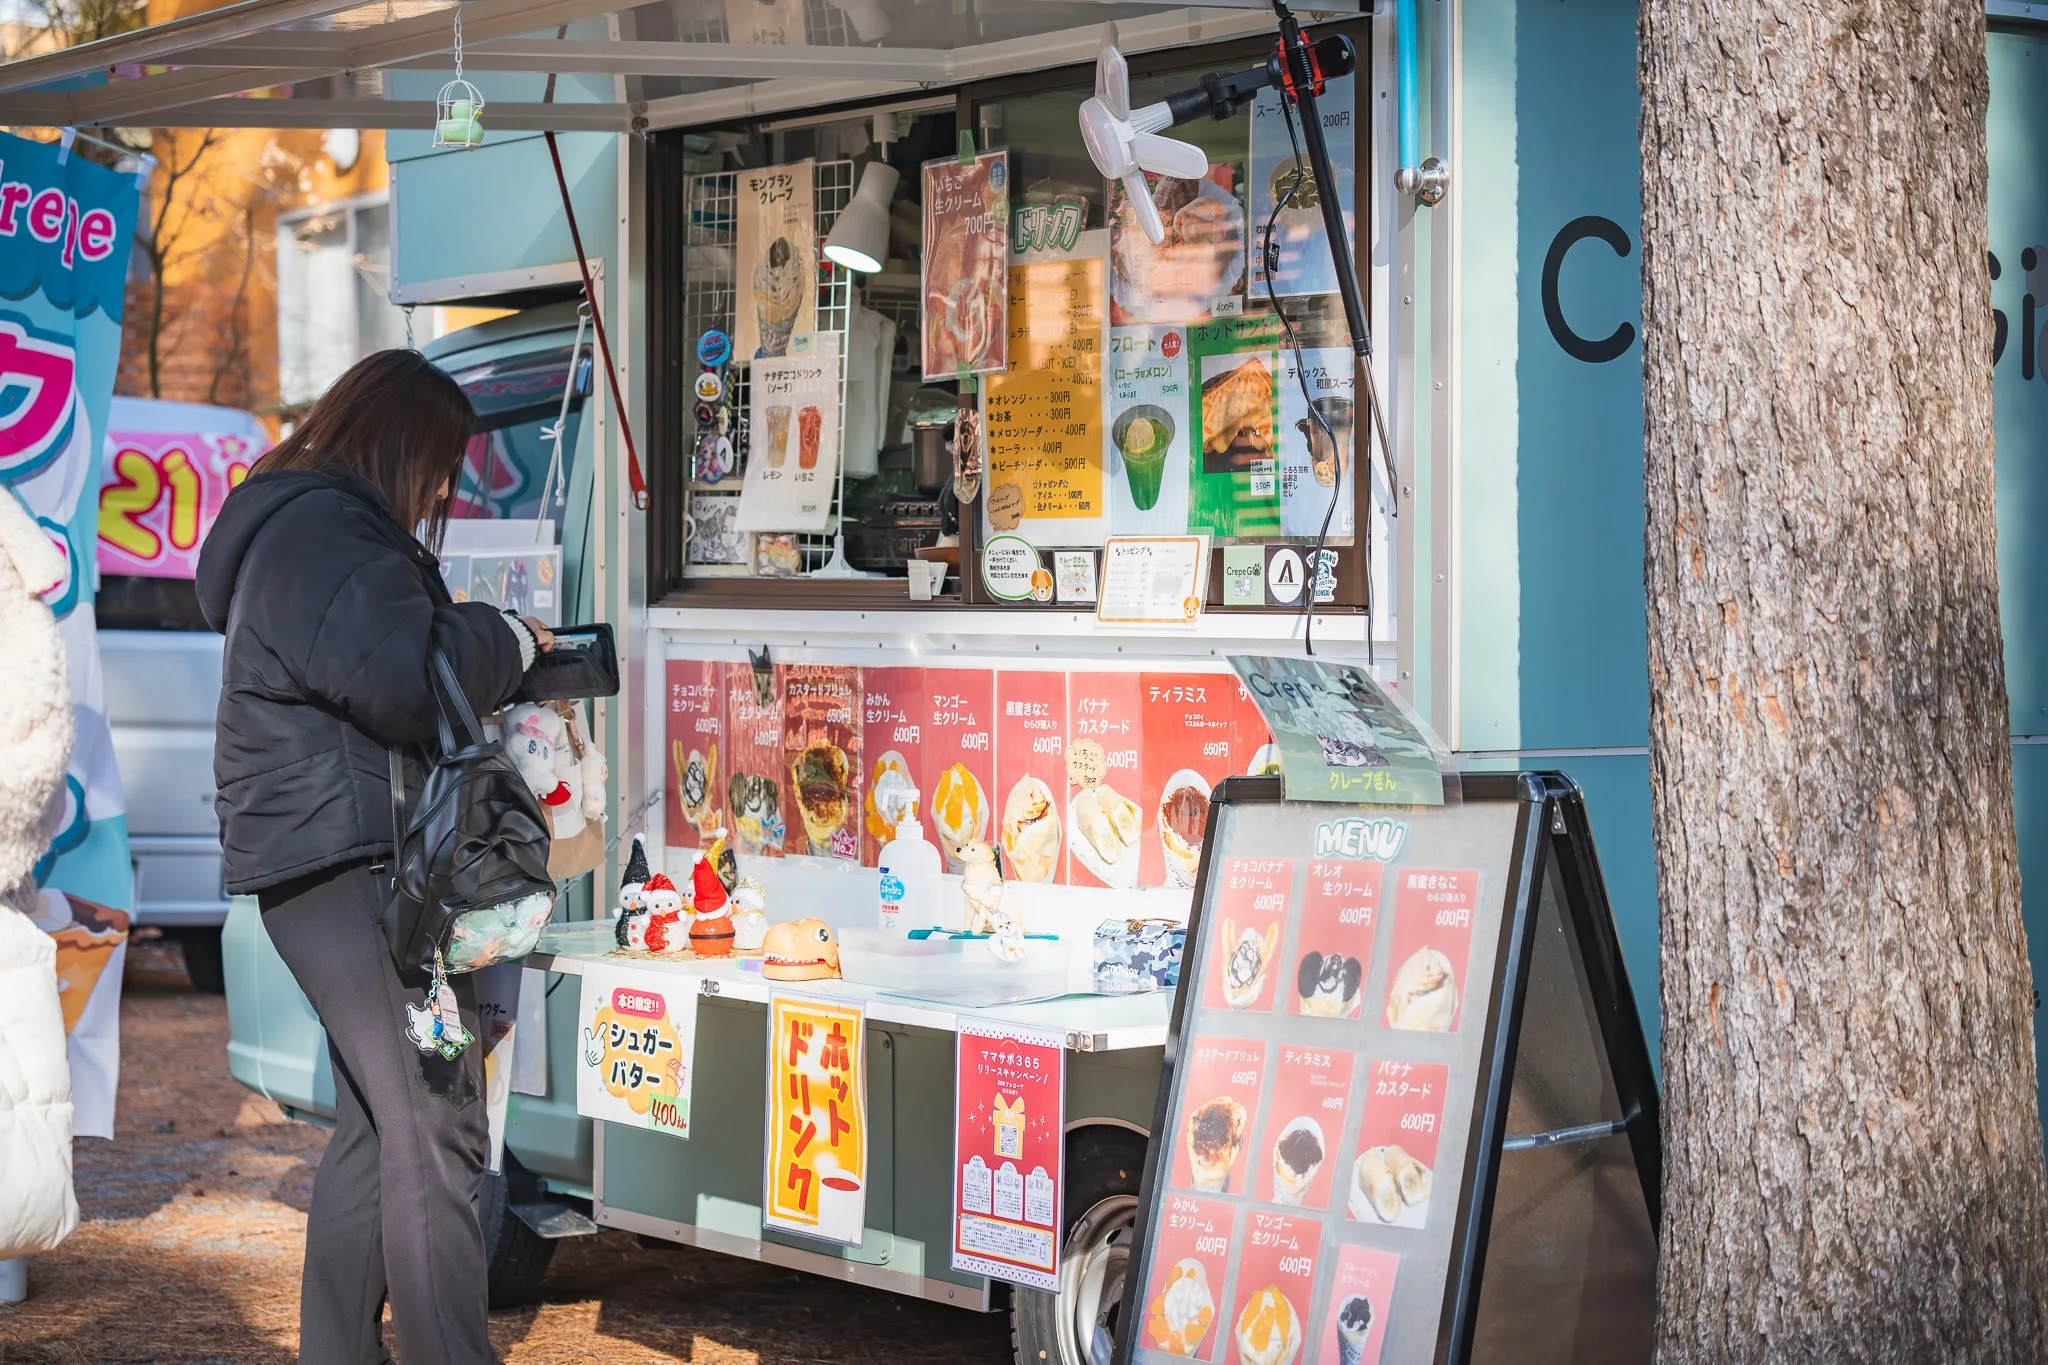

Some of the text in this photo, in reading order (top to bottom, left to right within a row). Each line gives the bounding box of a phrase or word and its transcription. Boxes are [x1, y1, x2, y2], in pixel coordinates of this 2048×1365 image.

[935, 175, 963, 192] いちご
[934, 192, 982, 215] 生クリーム
[0, 188, 116, 269] repe
[964, 212, 995, 236] 700円
[1017, 206, 1079, 249] ドリンク
[1111, 332, 1157, 354] フロート
[763, 368, 822, 382] ナタデココドリンク
[767, 382, 793, 394] (ソーダ)
[1162, 384, 1179, 393] 500円
[763, 470, 783, 481] レモン
[794, 471, 815, 482] いちご
[672, 683, 716, 698] チョコバナナ
[865, 693, 891, 706] みかん
[1149, 686, 1207, 703] ティラミス
[671, 699, 710, 713] 生クリーム
[933, 694, 968, 709] マンゴー
[1005, 700, 1049, 716] 黒蜜きなこ
[1077, 697, 1109, 714] バナナ
[826, 707, 852, 725] 650円
[865, 709, 907, 723] 生クリーム
[932, 711, 976, 726] 生クリーム
[695, 717, 719, 735] 600円
[893, 725, 920, 744] 600円
[1078, 717, 1130, 735] カスタード
[754, 729, 779, 748] 600円
[961, 732, 989, 751] 600円
[1032, 736, 1062, 755] 600円
[1073, 748, 1098, 761] いちご
[1203, 741, 1229, 758] 650円
[1106, 749, 1138, 769] 600円
[1329, 770, 1397, 792] クレープぎん
[833, 841, 856, 856] No.2
[1316, 819, 1403, 860] MENU
[1231, 861, 1284, 874] チョコバナナ
[1313, 864, 1344, 879] オレオ
[1229, 876, 1273, 890] 生クリーム
[1322, 881, 1373, 897] 生クリーム
[1406, 874, 1458, 890] 黒蜜きなこ
[1253, 894, 1284, 912] 600円
[1338, 908, 1372, 926] 600円
[1435, 908, 1470, 928] 600円
[616, 992, 660, 1014] 本日限定!!
[609, 1023, 673, 1056] シュガー
[981, 1050, 1040, 1070] ママサポ365
[1196, 1047, 1261, 1063] カスタードブリュレ
[1284, 1051, 1332, 1068] ティラミス
[610, 1061, 661, 1090] バター
[1377, 1060, 1413, 1077] バナナ
[820, 1022, 851, 1148] ホット
[1231, 1070, 1257, 1087] 650円
[1375, 1079, 1433, 1099] カスタード
[787, 1019, 817, 1212] ドリンク
[1400, 1112, 1436, 1133] 600円
[1172, 1196, 1199, 1214] みかん
[1169, 1212, 1214, 1234] 生クリーム
[1254, 1213, 1293, 1230] マンゴー
[1195, 1235, 1228, 1257] 600円
[1251, 1229, 1299, 1251] 生クリーム
[1278, 1255, 1313, 1278] 600円
